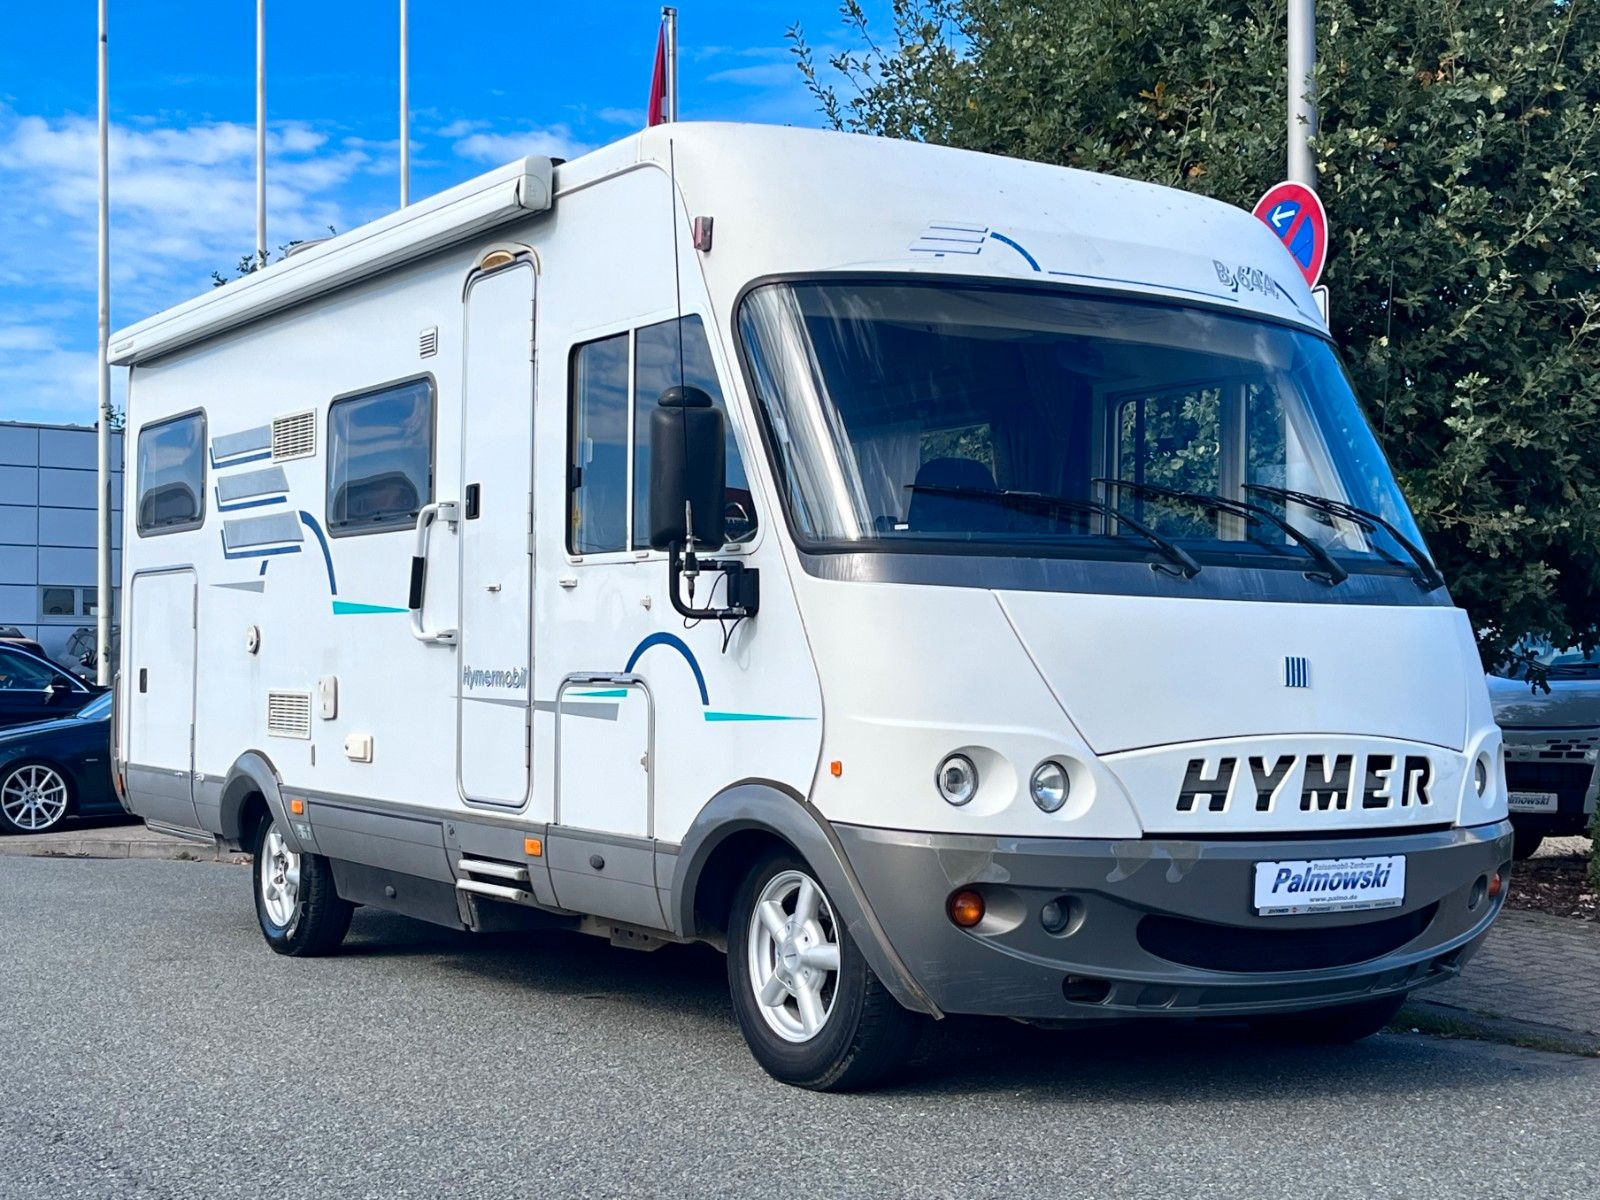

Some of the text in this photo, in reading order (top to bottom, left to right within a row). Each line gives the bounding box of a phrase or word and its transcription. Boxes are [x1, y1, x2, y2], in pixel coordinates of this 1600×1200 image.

[463, 664, 528, 690] Hymermobil
[1176, 754, 1432, 812] HYMER
[1272, 862, 1393, 894] Palmowski
